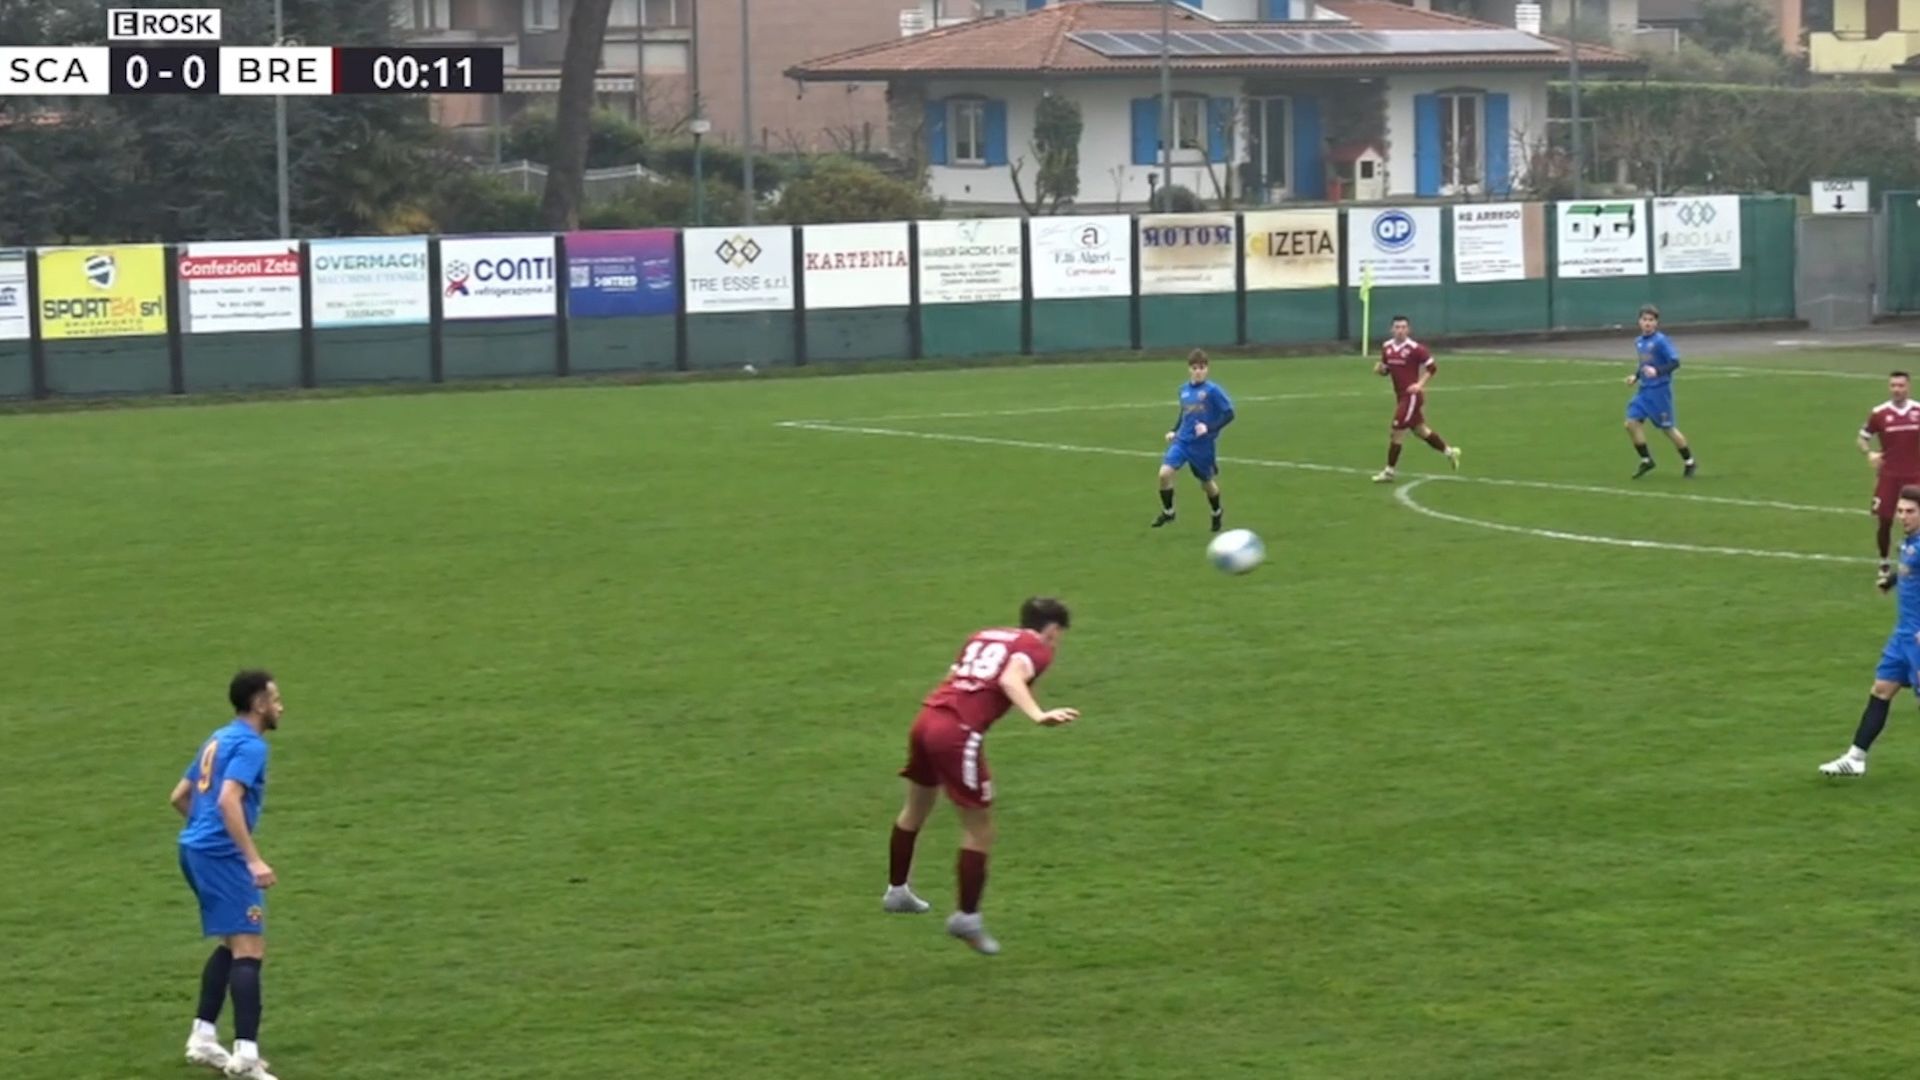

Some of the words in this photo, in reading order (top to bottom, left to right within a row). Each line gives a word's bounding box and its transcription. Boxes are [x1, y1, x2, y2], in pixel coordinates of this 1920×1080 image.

[1142, 224, 1233, 248] MOTOM
[1379, 219, 1410, 239] OP
[180, 259, 262, 276] Confezioni
[264, 257, 299, 274] Zeta
[315, 252, 426, 271] OVERMACH
[474, 256, 553, 282] CONTI
[805, 250, 908, 271] KARTENIA
[474, 285, 553, 298] refrigerazione.it
[689, 277, 719, 292] TRE
[722, 275, 761, 292] ESSE
[43, 297, 138, 320] SPORT24
[140, 295, 163, 318] srl
[197, 739, 219, 793] 9
